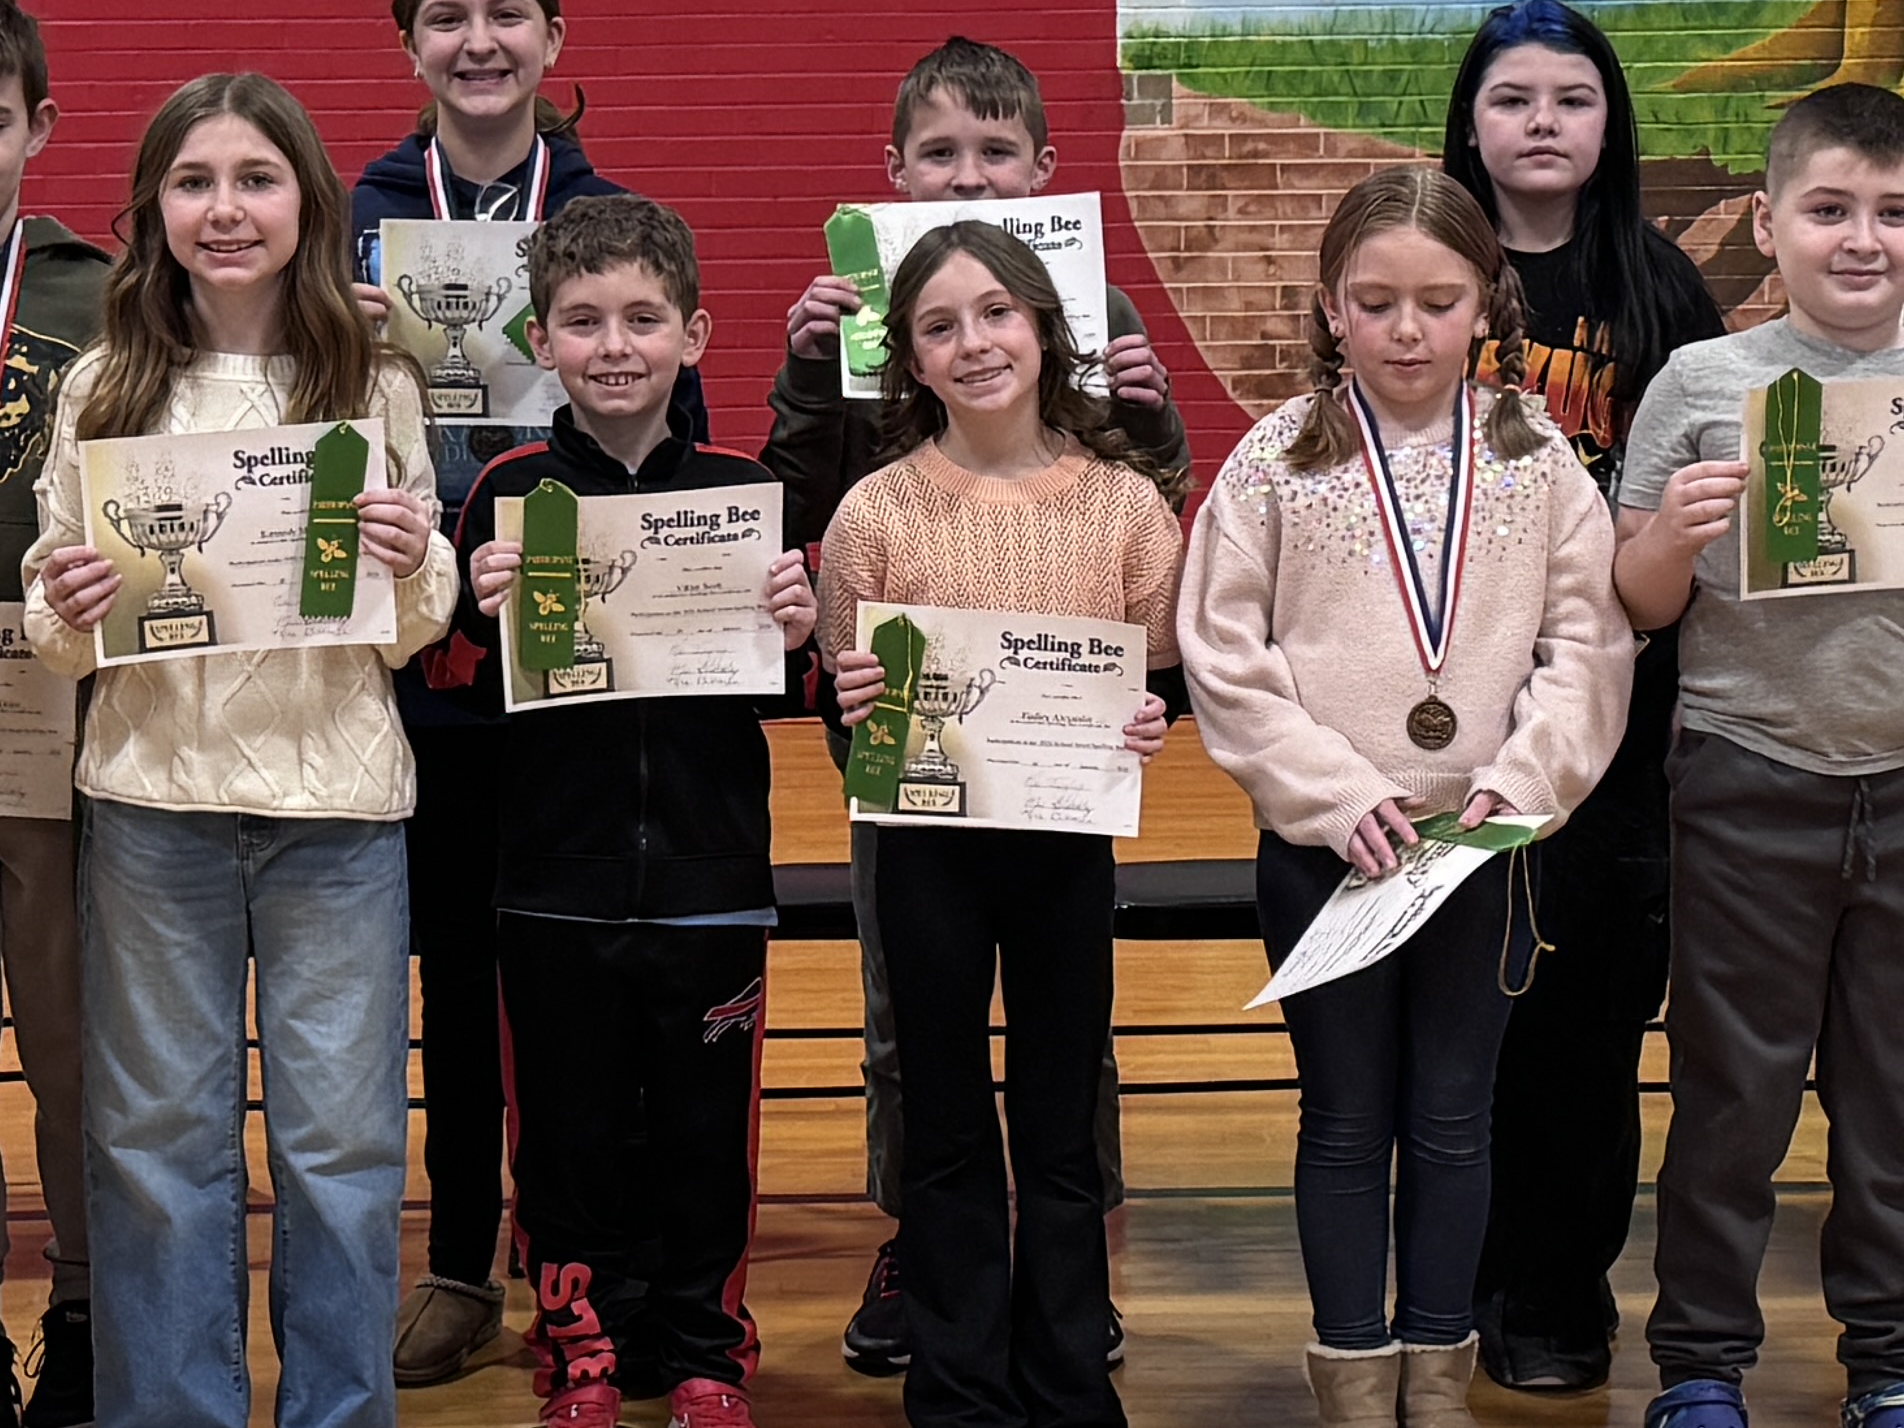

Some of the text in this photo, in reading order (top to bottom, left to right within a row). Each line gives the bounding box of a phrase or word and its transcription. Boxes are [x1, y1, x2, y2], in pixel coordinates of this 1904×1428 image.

[1003, 215, 1083, 239] lling Bee
[232, 447, 316, 472] Spelling
[258, 471, 313, 488] Certifi
[640, 506, 761, 534] Spelling Bee
[663, 532, 739, 547] Certificate
[1000, 631, 1124, 659] Spelling Bee
[1022, 657, 1101, 674] Certificate
